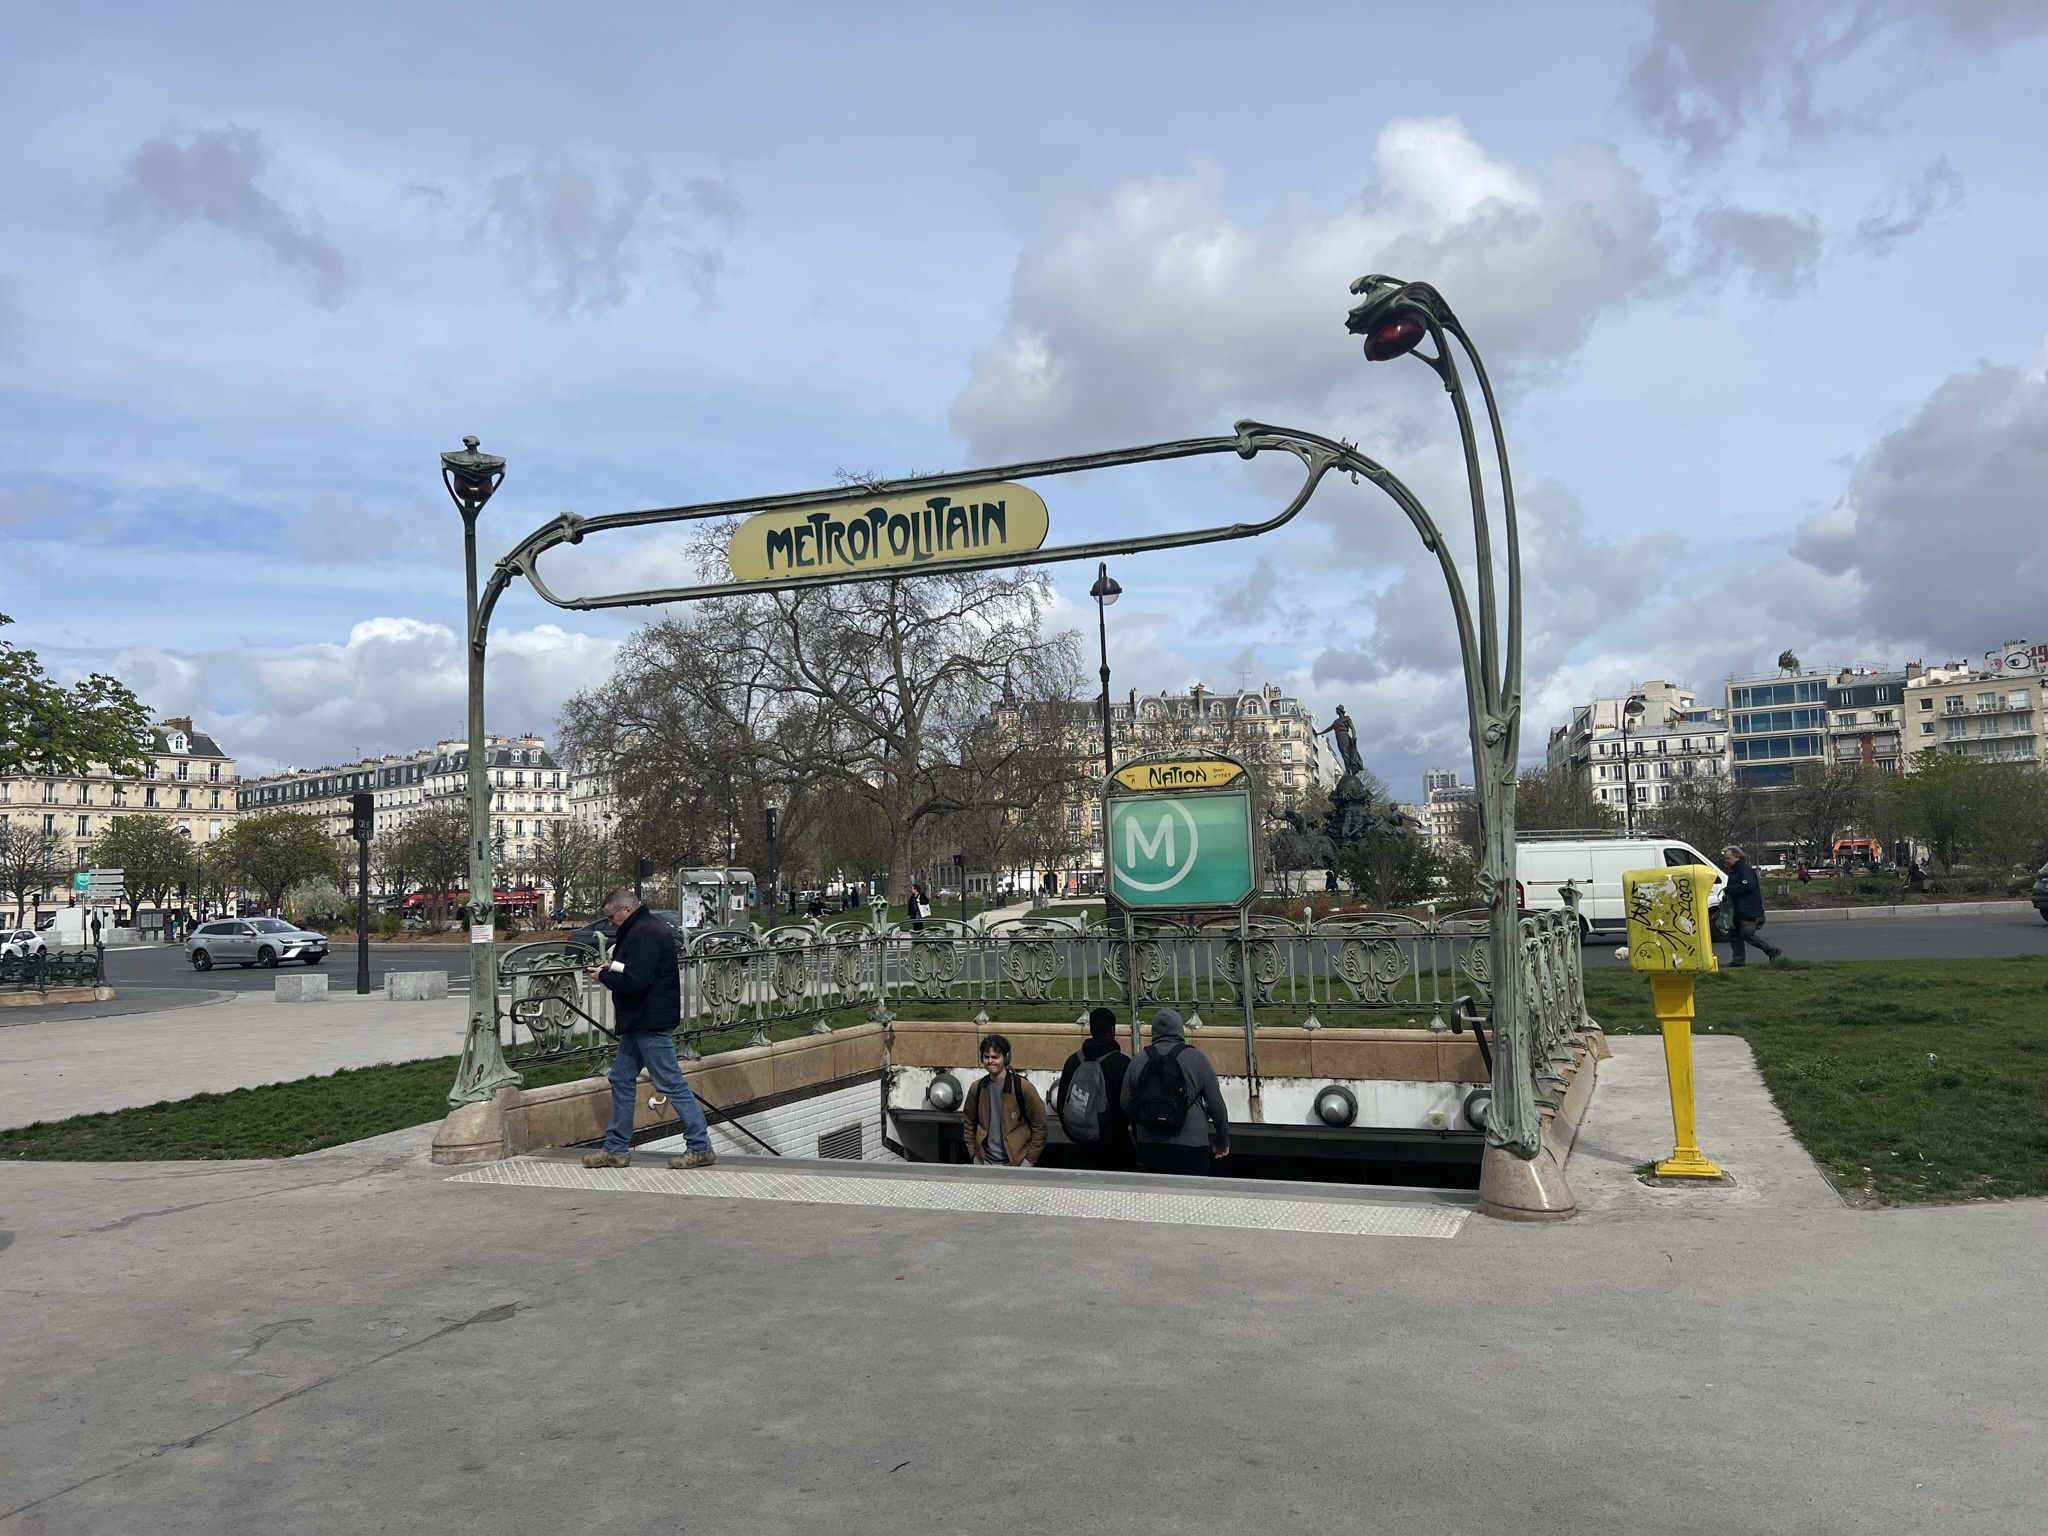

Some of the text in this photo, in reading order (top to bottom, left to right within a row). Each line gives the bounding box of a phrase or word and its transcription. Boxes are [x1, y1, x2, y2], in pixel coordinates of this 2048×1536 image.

[766, 497, 1007, 571] METROPOLITAIN
[1149, 766, 1207, 788] NATION
[1125, 814, 1175, 869] M
